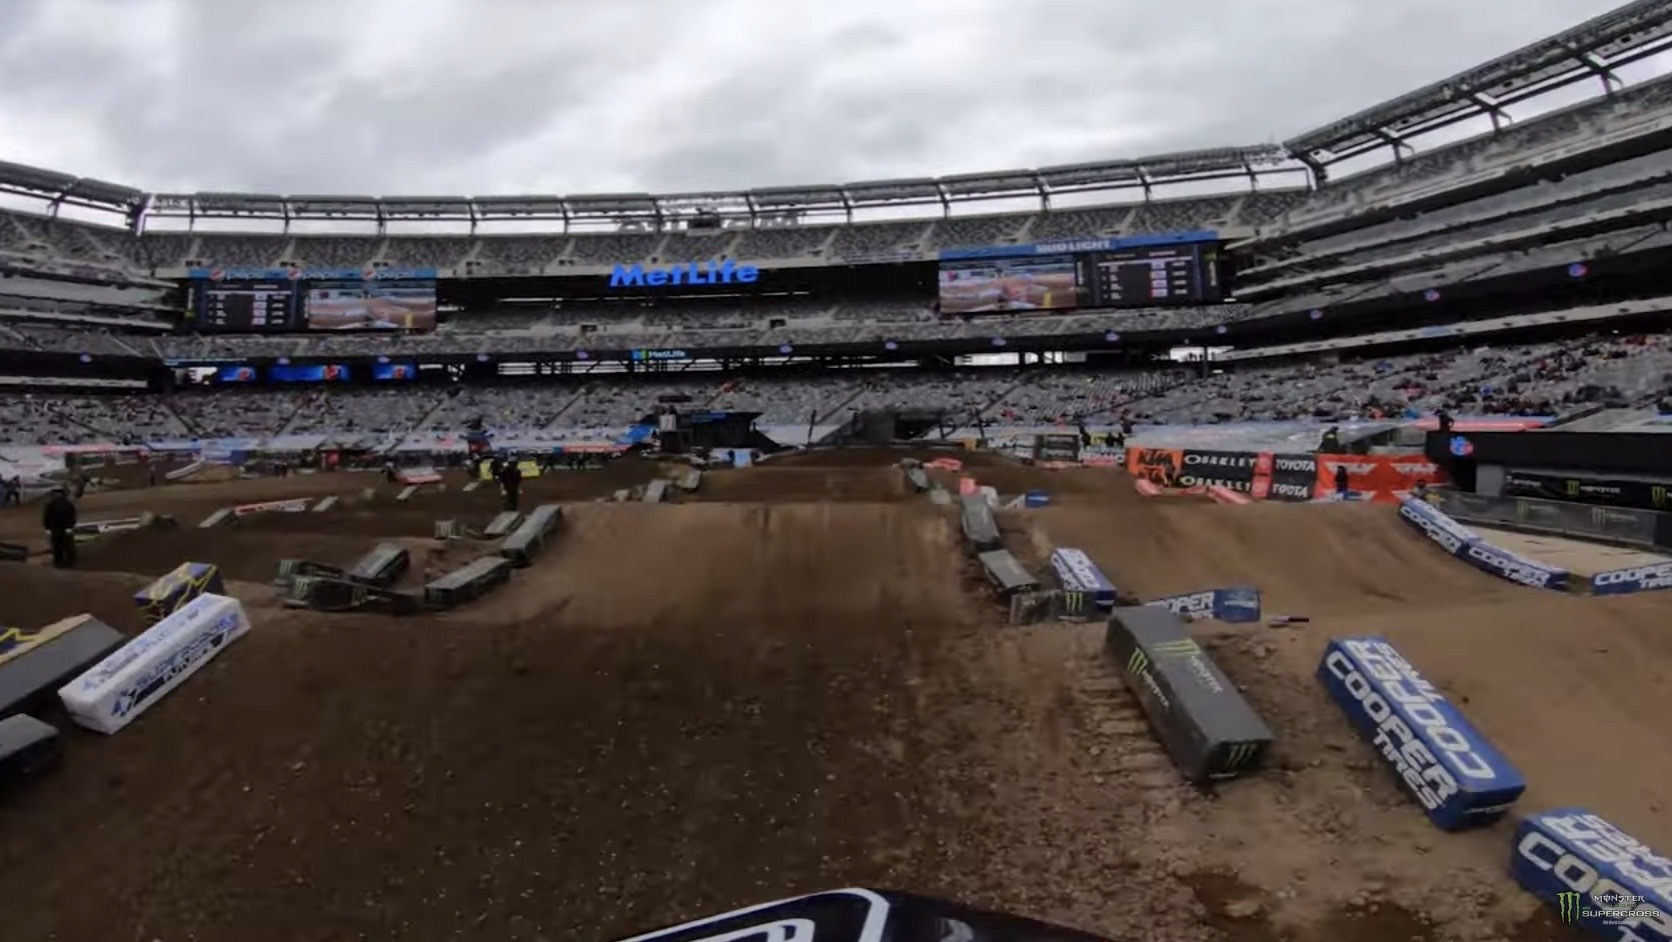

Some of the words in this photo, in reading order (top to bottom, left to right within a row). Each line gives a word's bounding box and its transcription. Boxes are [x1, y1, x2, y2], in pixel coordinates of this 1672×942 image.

[1069, 240, 1110, 252] LIGHT
[610, 259, 759, 287] MetLife
[1276, 459, 1316, 472] TOYOTA
[1400, 506, 1461, 549] COOPER
[1469, 547, 1551, 584] COOPER
[1326, 650, 1459, 800] COOPER
[1345, 639, 1496, 780] COOPER
[1372, 727, 1447, 811] TIRES
